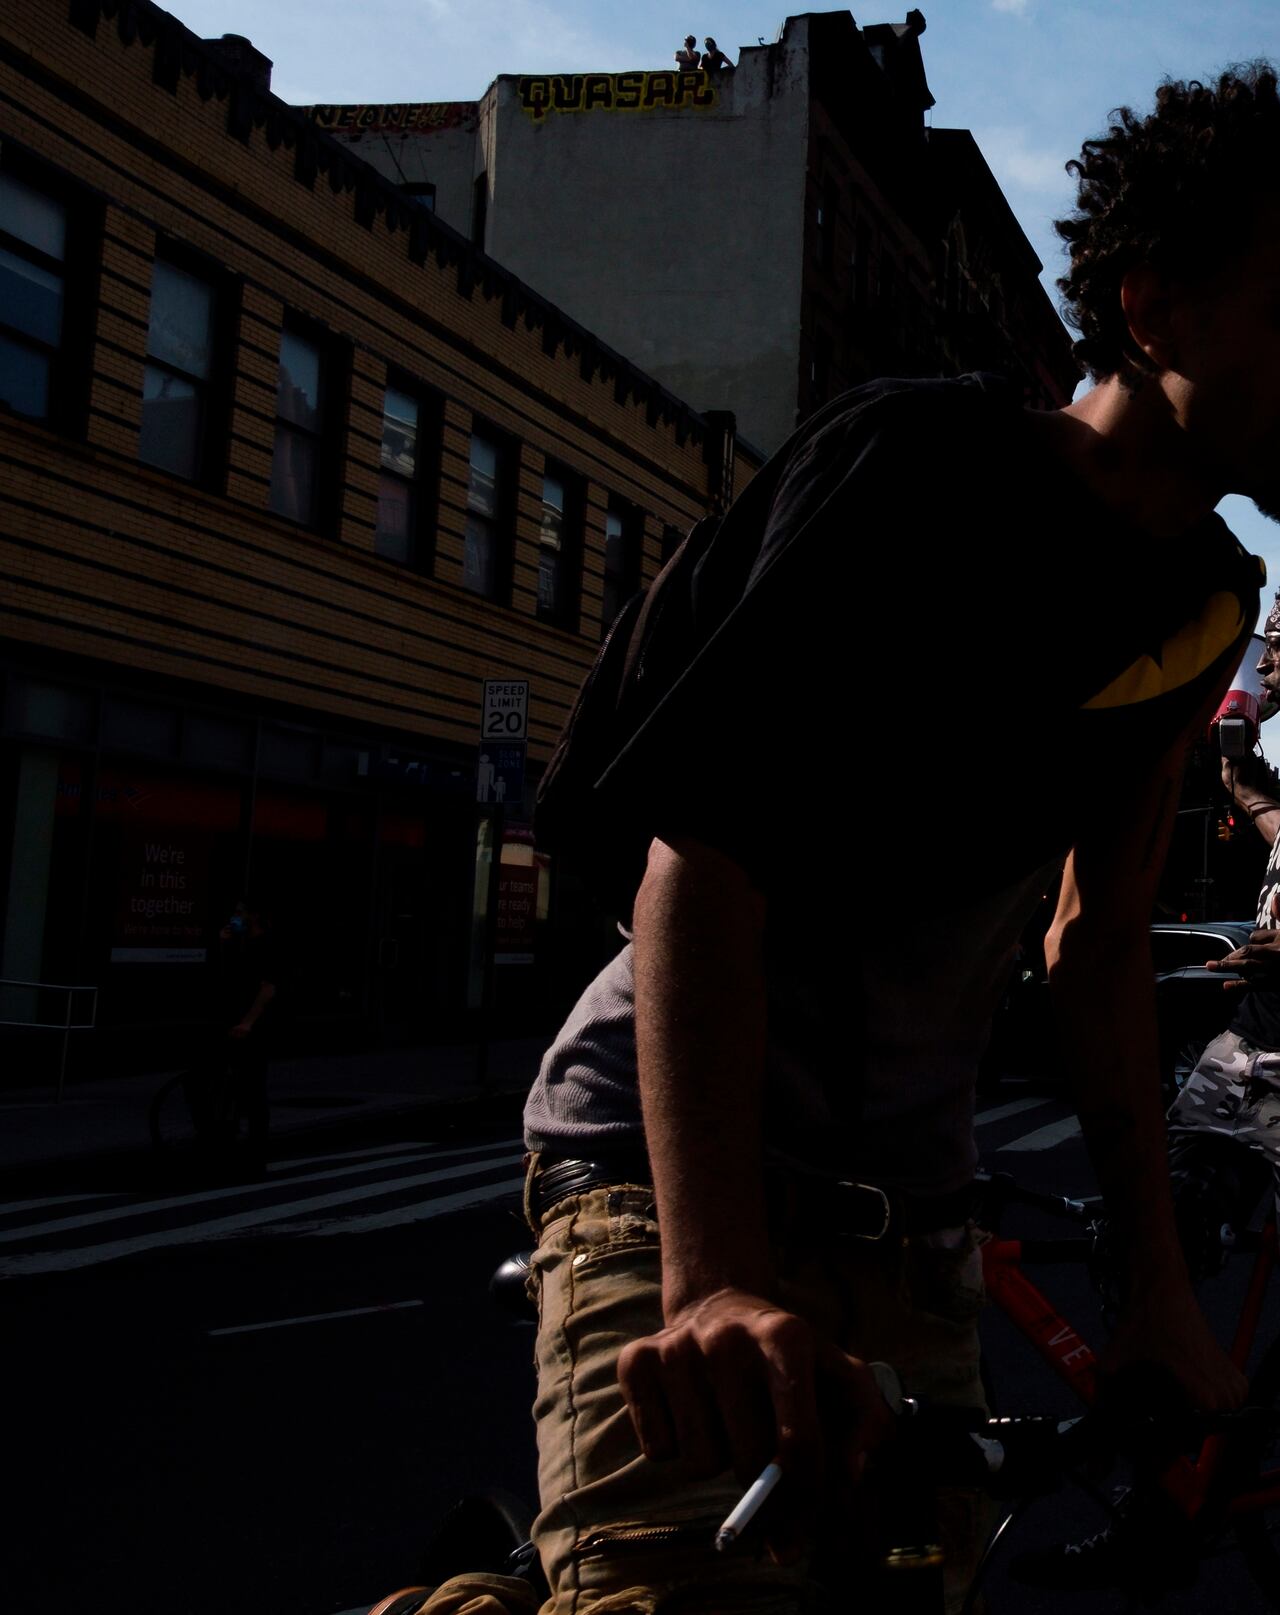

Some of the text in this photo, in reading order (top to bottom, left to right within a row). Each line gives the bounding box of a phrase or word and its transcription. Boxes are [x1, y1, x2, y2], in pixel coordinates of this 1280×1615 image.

[520, 71, 716, 124] QUASAR
[488, 685, 525, 696] SPEED
[490, 697, 521, 708] LIMIT
[487, 711, 522, 733] 20
[144, 842, 184, 865] We're
[140, 865, 187, 890] in this
[130, 897, 196, 919] together
